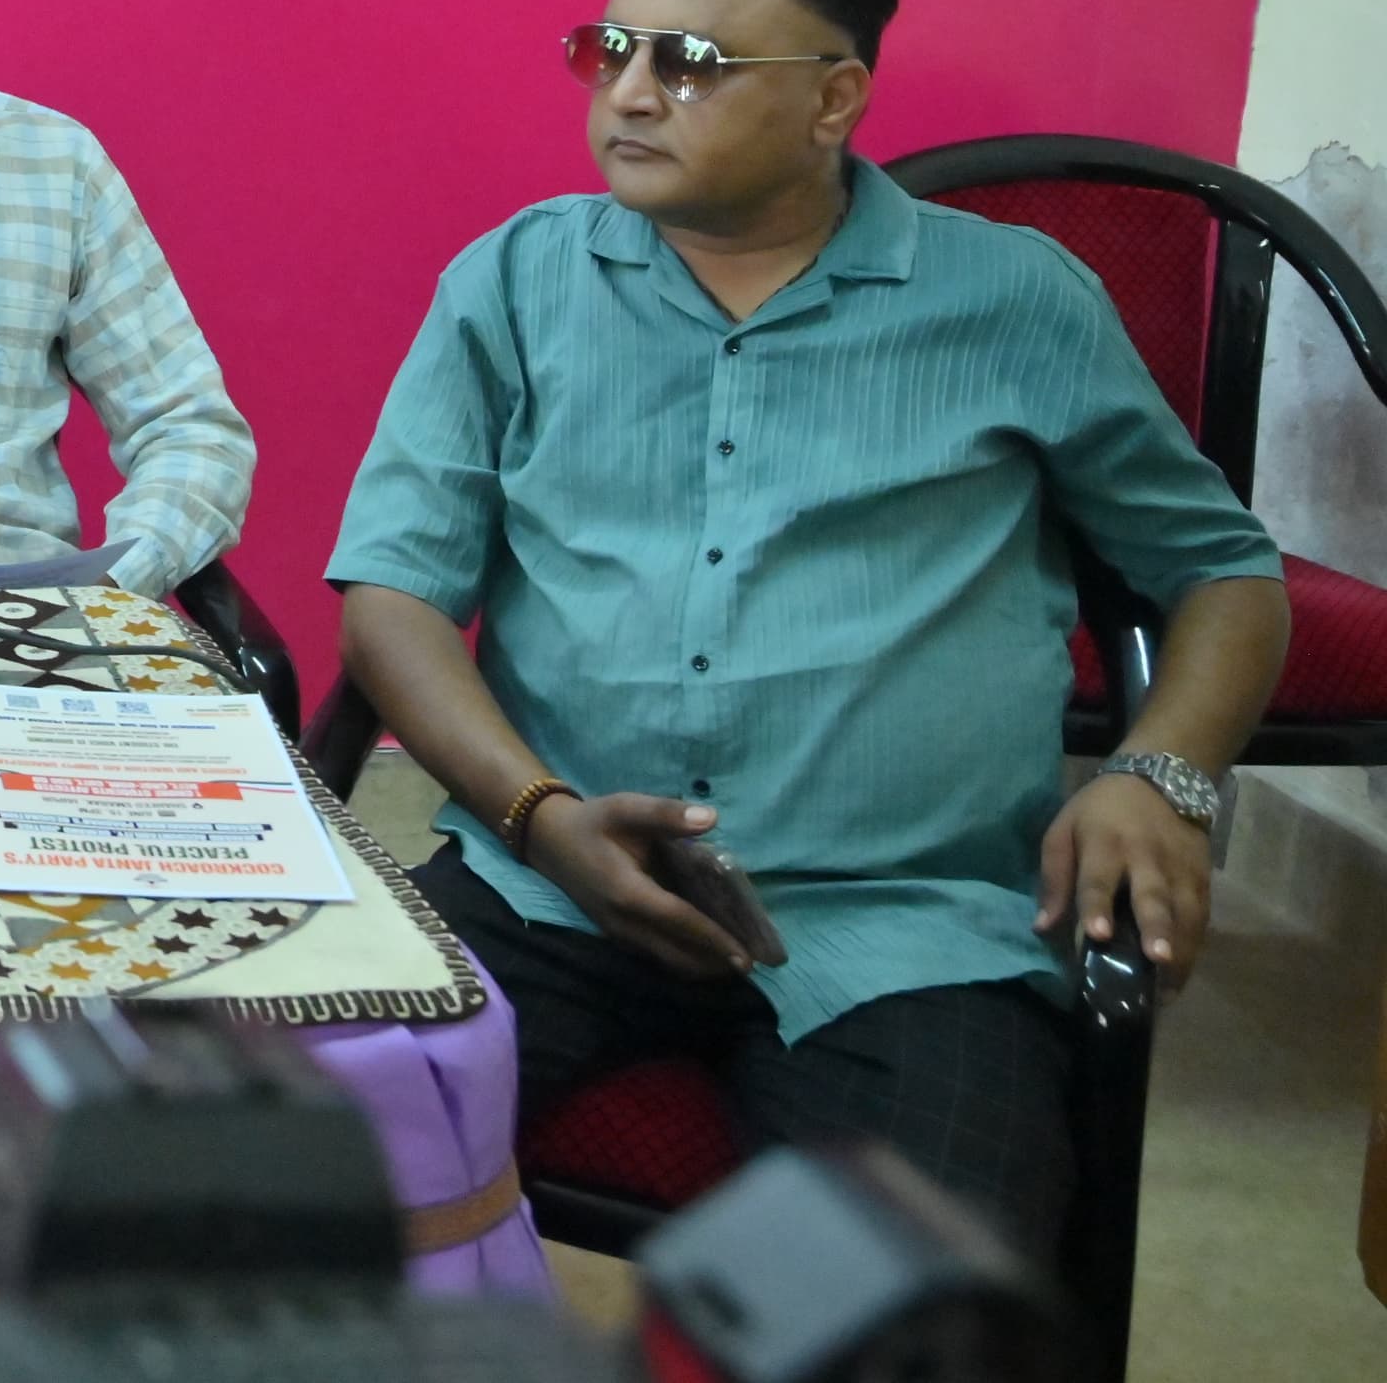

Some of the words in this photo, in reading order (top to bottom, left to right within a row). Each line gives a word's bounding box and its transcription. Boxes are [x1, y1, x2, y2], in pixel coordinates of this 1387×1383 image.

[30, 835, 128, 856] PROTEST
[134, 842, 249, 859] PEACEFUL
[3, 851, 88, 869] PARTY'S
[92, 856, 152, 871] JANTA
[156, 860, 286, 875] COCKROACH
